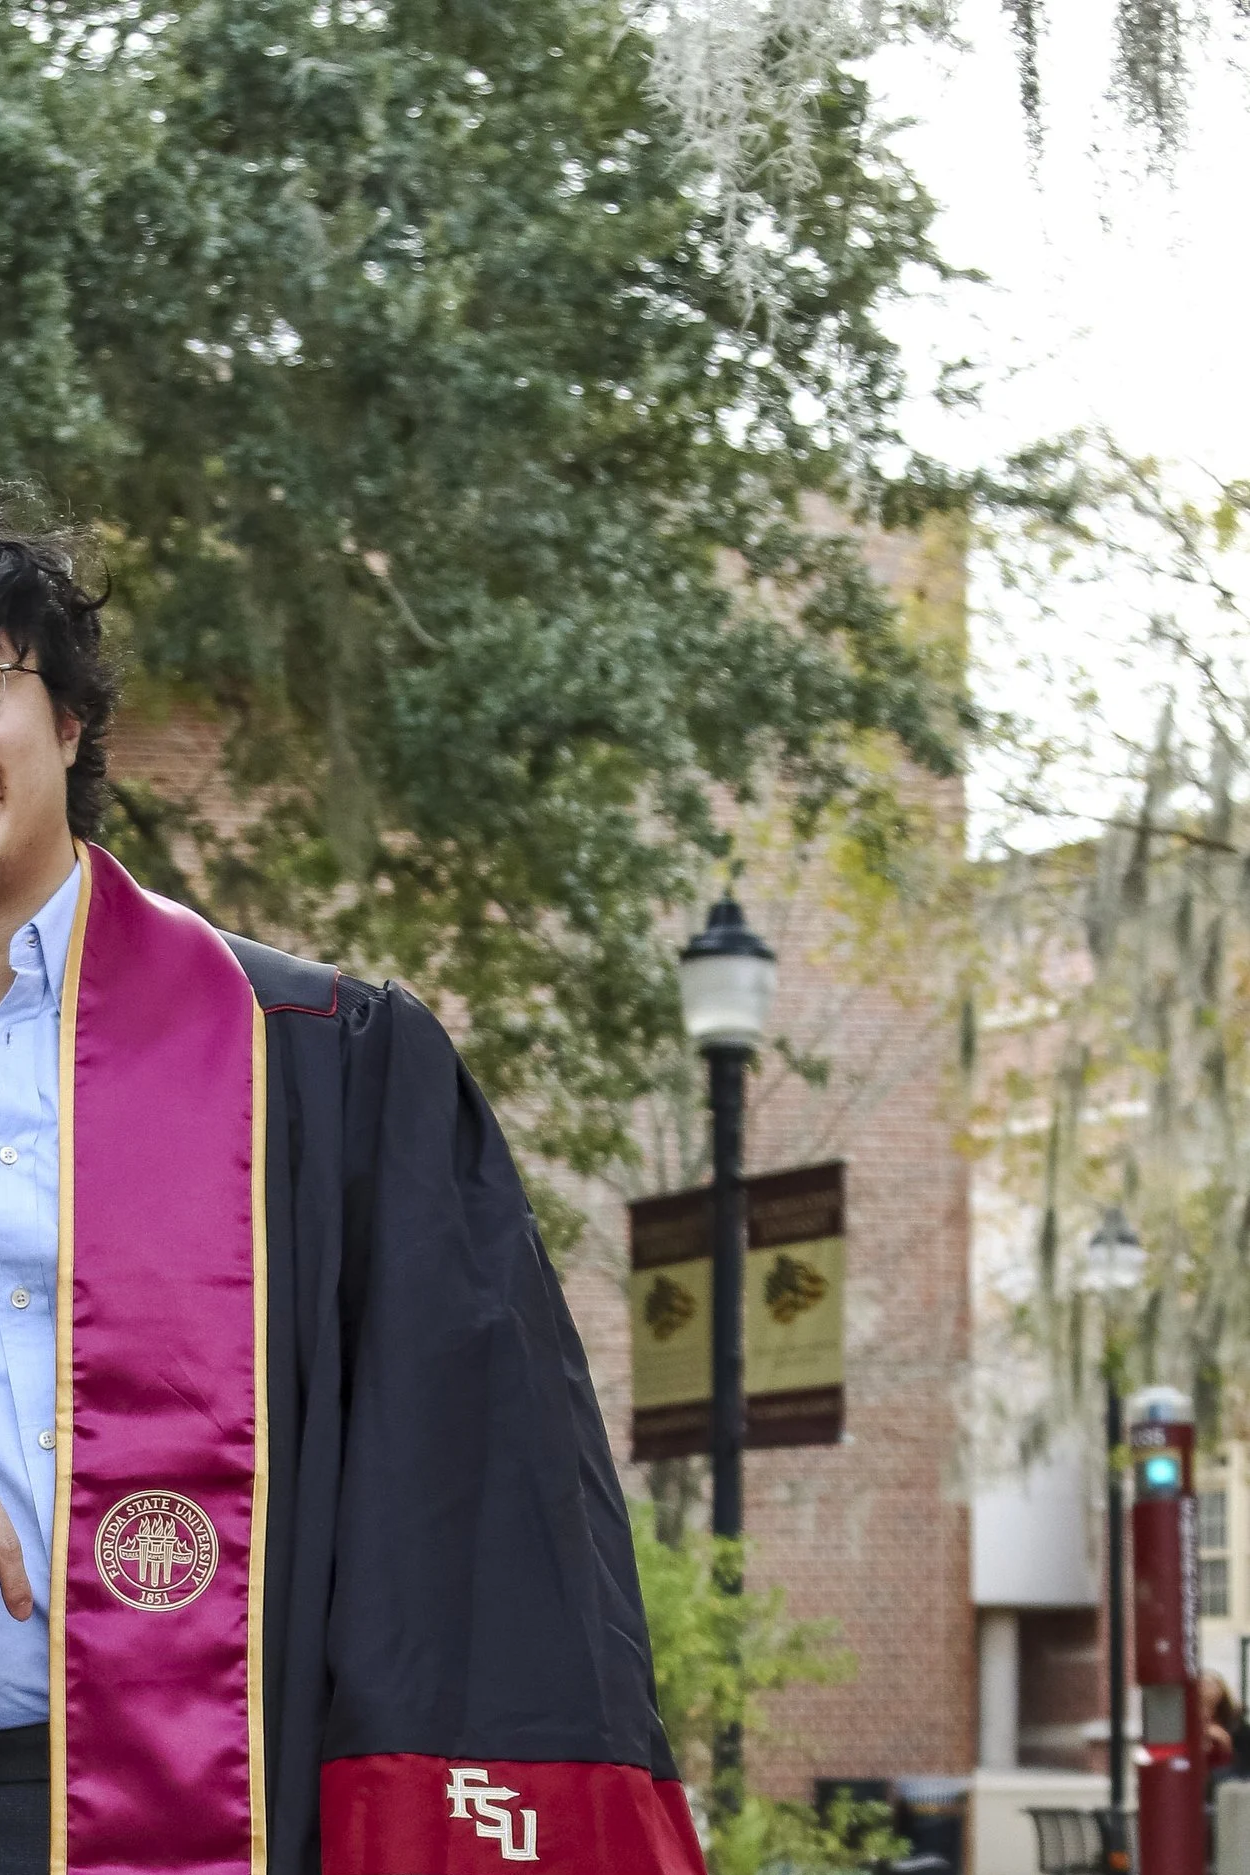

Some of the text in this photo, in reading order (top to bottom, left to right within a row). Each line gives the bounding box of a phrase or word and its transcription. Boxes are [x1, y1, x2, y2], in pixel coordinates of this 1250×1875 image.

[102, 1497, 211, 1586] FLORIDA STATE UNIVERSITY
[139, 1591, 170, 1604] 1851
[446, 1767, 540, 1861] FSU
